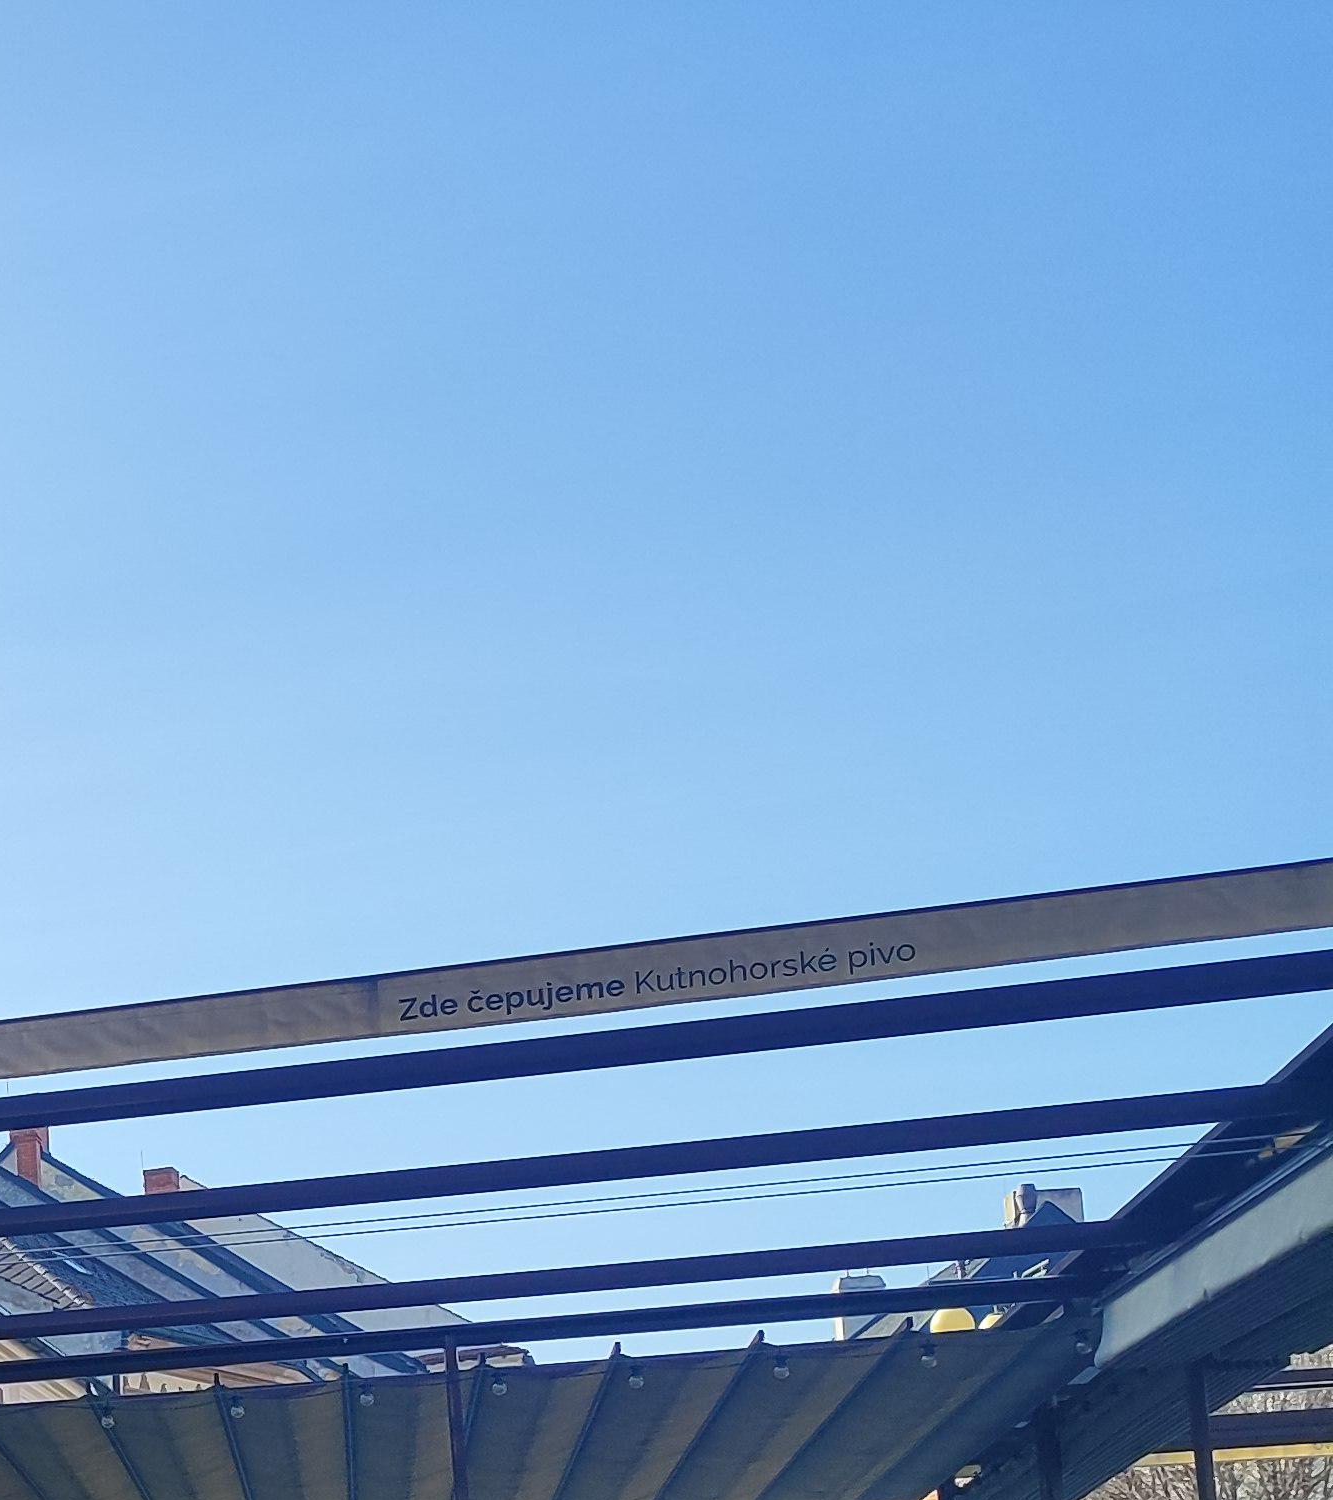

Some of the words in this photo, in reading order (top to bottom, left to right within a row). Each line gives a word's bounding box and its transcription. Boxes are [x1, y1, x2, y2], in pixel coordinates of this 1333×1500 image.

[399, 996, 458, 1022] Zde
[467, 976, 625, 1016] čepujeme
[634, 948, 838, 994] Kutnohorské
[846, 941, 916, 976] pivo
